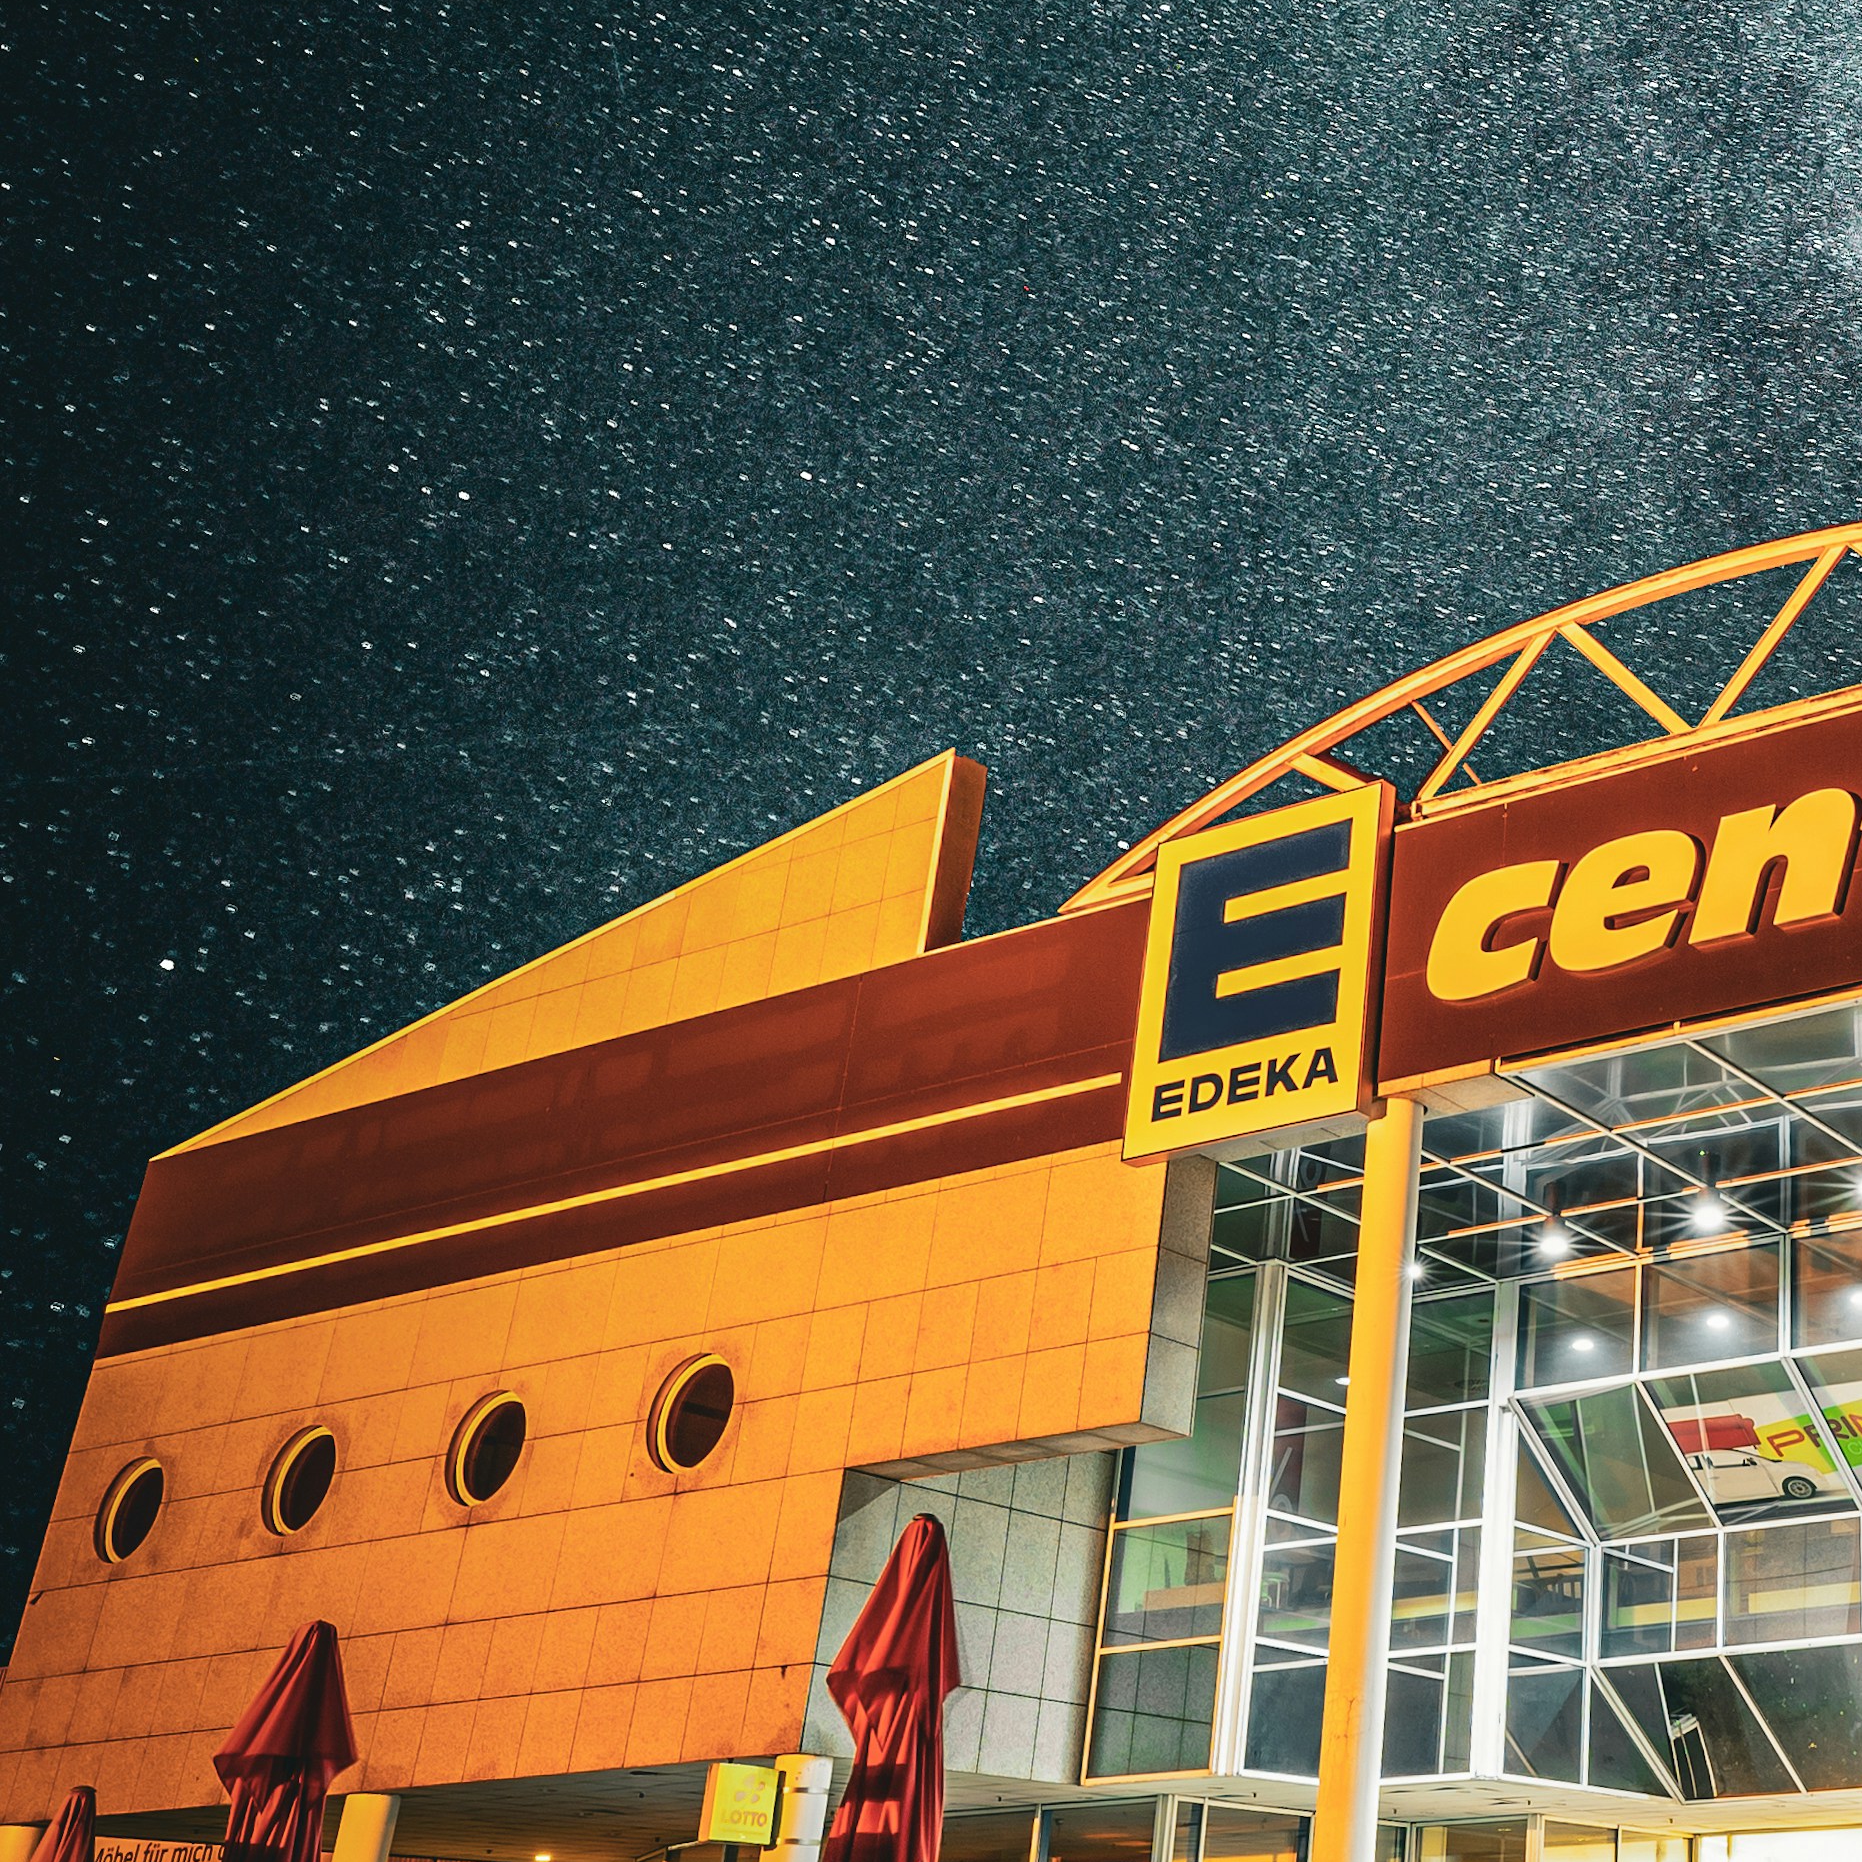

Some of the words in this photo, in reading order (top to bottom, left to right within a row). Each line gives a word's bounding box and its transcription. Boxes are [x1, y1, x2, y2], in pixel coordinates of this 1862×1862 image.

[1158, 817, 1353, 1064] E
[1151, 1047, 1338, 1122] EDEKA
[721, 1809, 768, 1828] LOTTO
